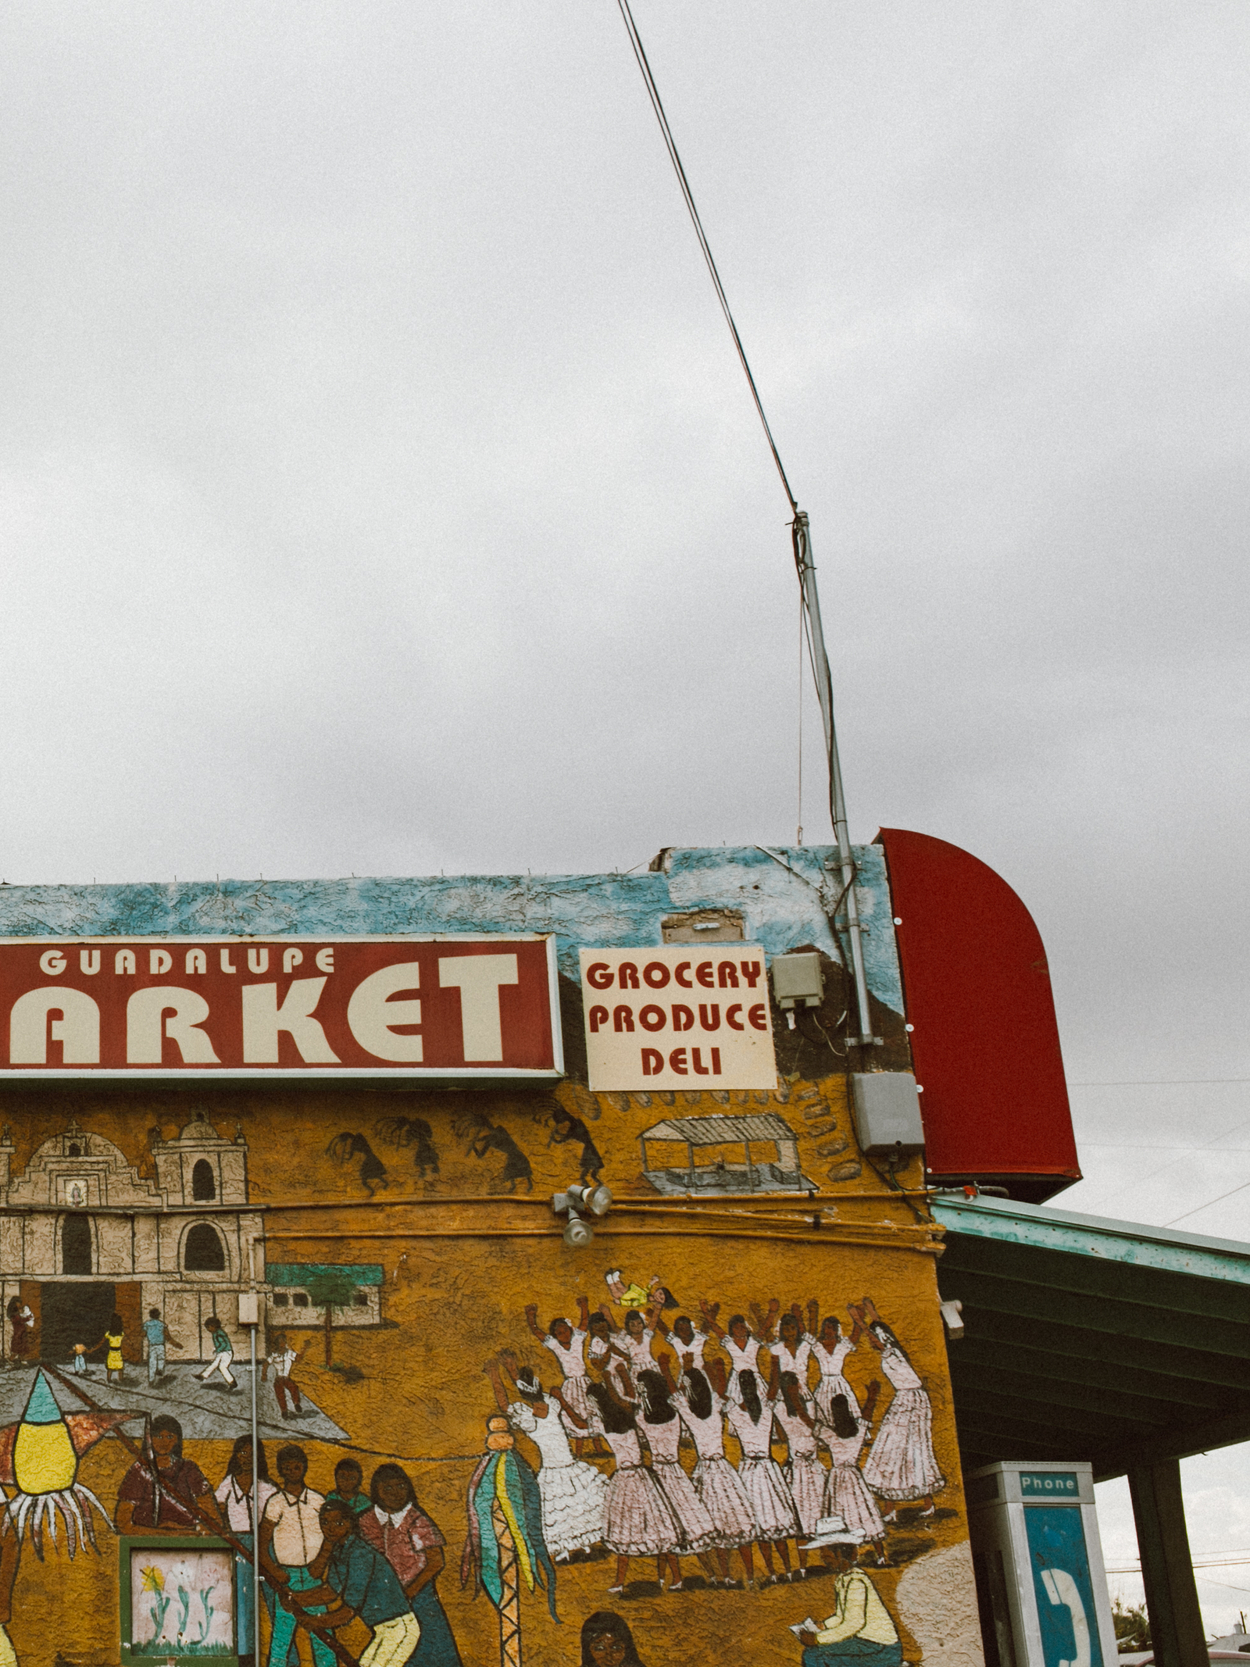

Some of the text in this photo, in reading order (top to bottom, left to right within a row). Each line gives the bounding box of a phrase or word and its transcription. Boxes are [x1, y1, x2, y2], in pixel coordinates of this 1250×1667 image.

[39, 947, 336, 976] GUADALUPE
[586, 961, 761, 990] GROCERY
[589, 1003, 767, 1033] PRODUCE
[641, 1047, 722, 1075] DELI
[1021, 1477, 1074, 1489] Phone
